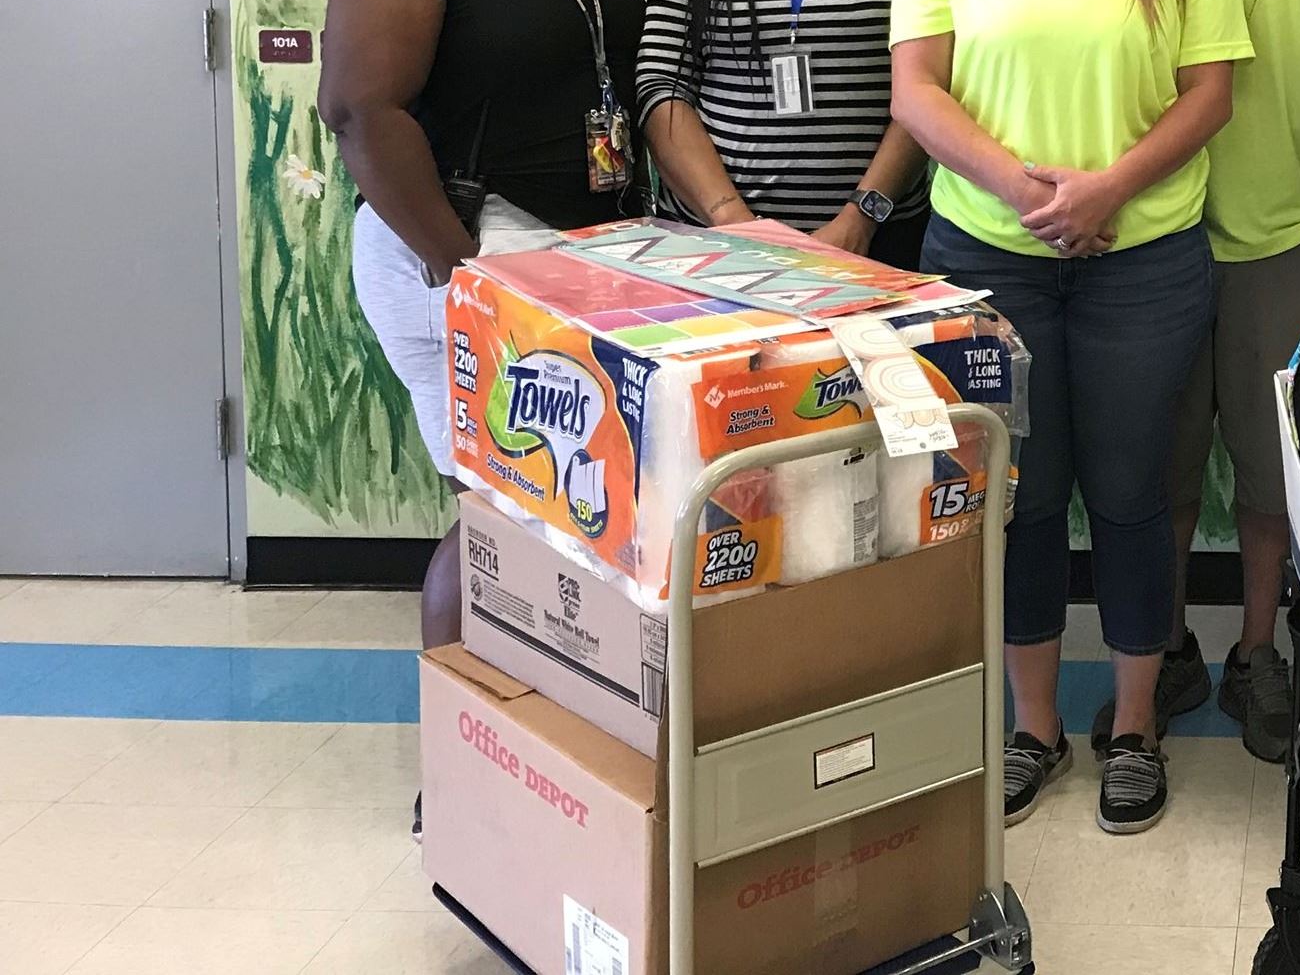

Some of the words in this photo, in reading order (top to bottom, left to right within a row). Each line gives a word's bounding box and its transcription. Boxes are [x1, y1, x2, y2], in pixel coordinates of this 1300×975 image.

[272, 37, 298, 47] 101A
[964, 348, 1001, 365] THICK
[622, 357, 648, 385] THICK
[975, 365, 1002, 377] LONG
[505, 363, 591, 440] Towels
[727, 385, 764, 399] Member's
[814, 376, 864, 409] Tow
[729, 408, 760, 423] Strong
[760, 403, 770, 416] &
[726, 417, 776, 436] Absorbent
[487, 453, 508, 481] Strong
[512, 468, 546, 502] Absorbent
[576, 498, 593, 523] 150
[930, 482, 968, 518] 15
[709, 531, 740, 551] OVER
[929, 521, 961, 541] 150
[468, 538, 499, 575] RH714
[707, 542, 758, 573] 2200
[701, 564, 753, 587] SHEETS
[458, 710, 520, 779] Office
[524, 763, 589, 828] DEPOT
[737, 860, 833, 910] Office
